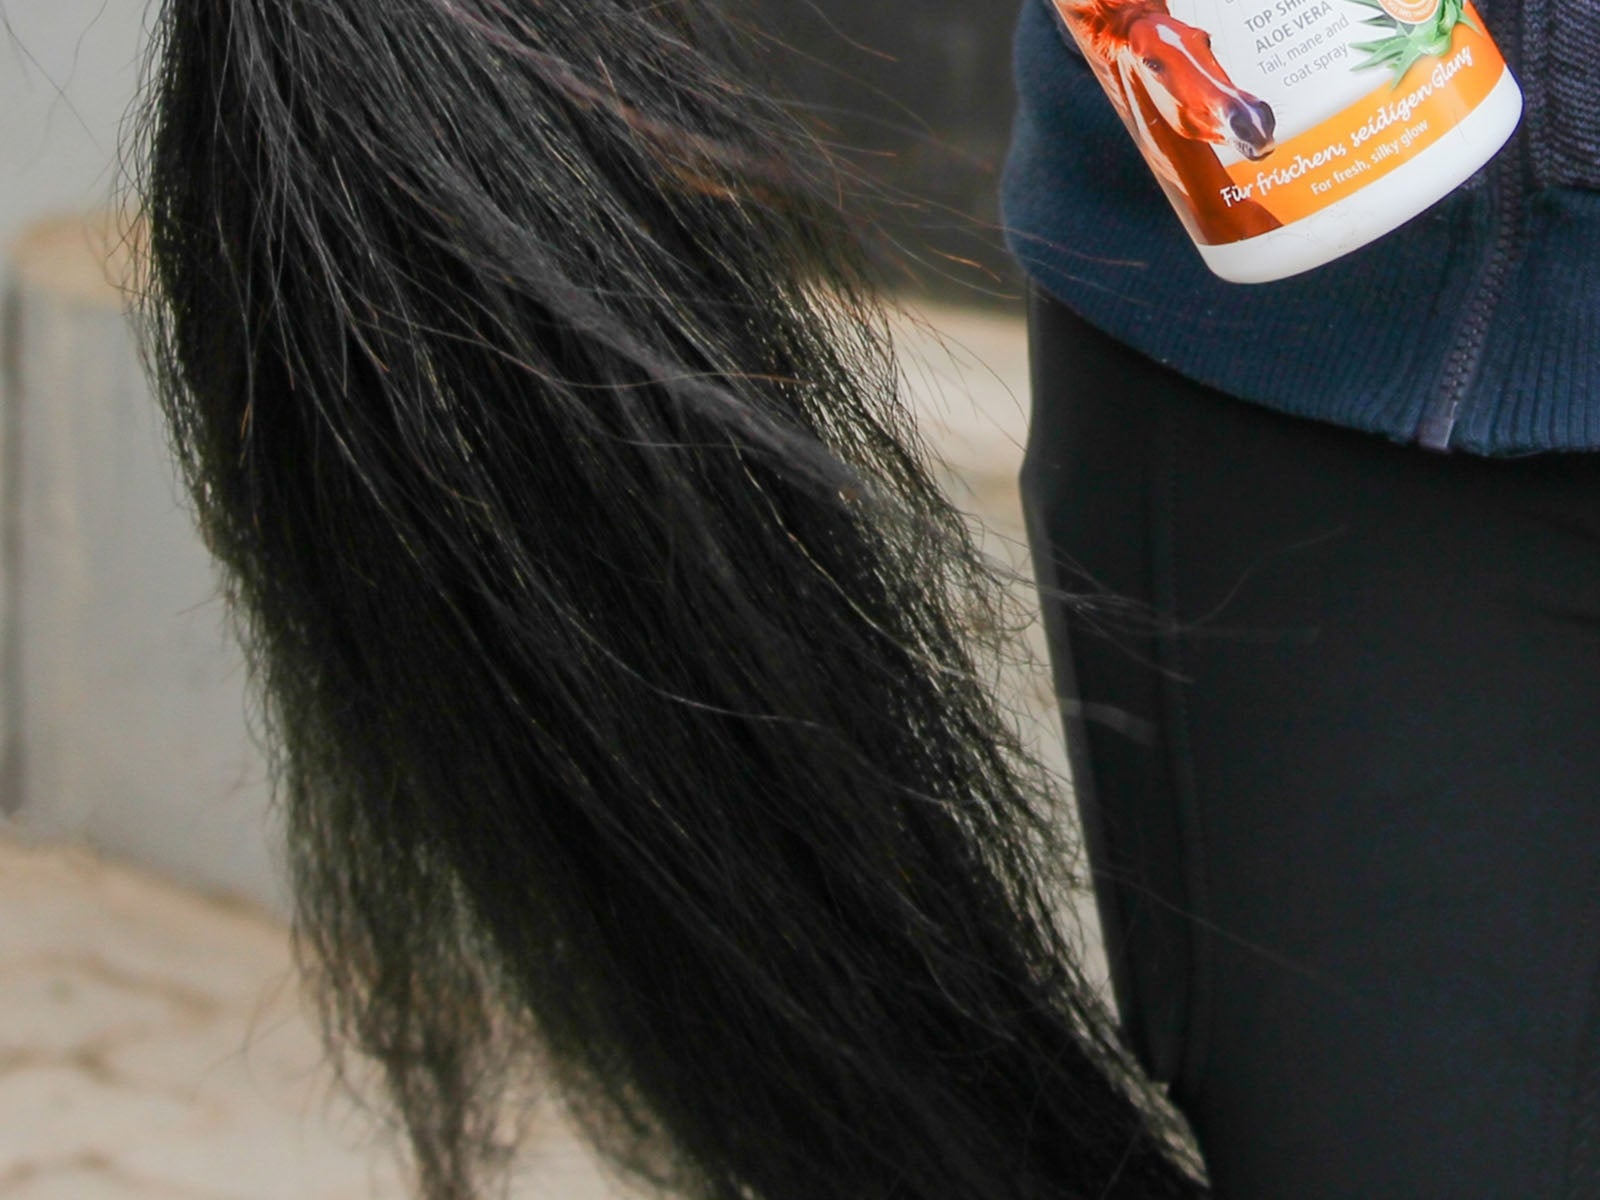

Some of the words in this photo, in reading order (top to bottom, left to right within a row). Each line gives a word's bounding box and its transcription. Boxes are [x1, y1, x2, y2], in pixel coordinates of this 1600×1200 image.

[1244, 8, 1273, 33] TOP
[1255, 24, 1294, 54] ALOE
[1292, 0, 1333, 30] VERA
[1257, 50, 1287, 75] Tail,
[1286, 34, 1326, 61] mane
[1325, 13, 1350, 39] and
[1283, 64, 1313, 87] coat
[1312, 42, 1350, 71] spray
[1219, 182, 1254, 208] Für
[1256, 142, 1348, 196] frischen,
[1350, 82, 1434, 148] seidigen
[1431, 44, 1474, 90] Glanz
[1310, 177, 1333, 196] For
[1332, 158, 1372, 185] fresh,
[1370, 140, 1400, 165] silky
[1399, 119, 1430, 148] glow
